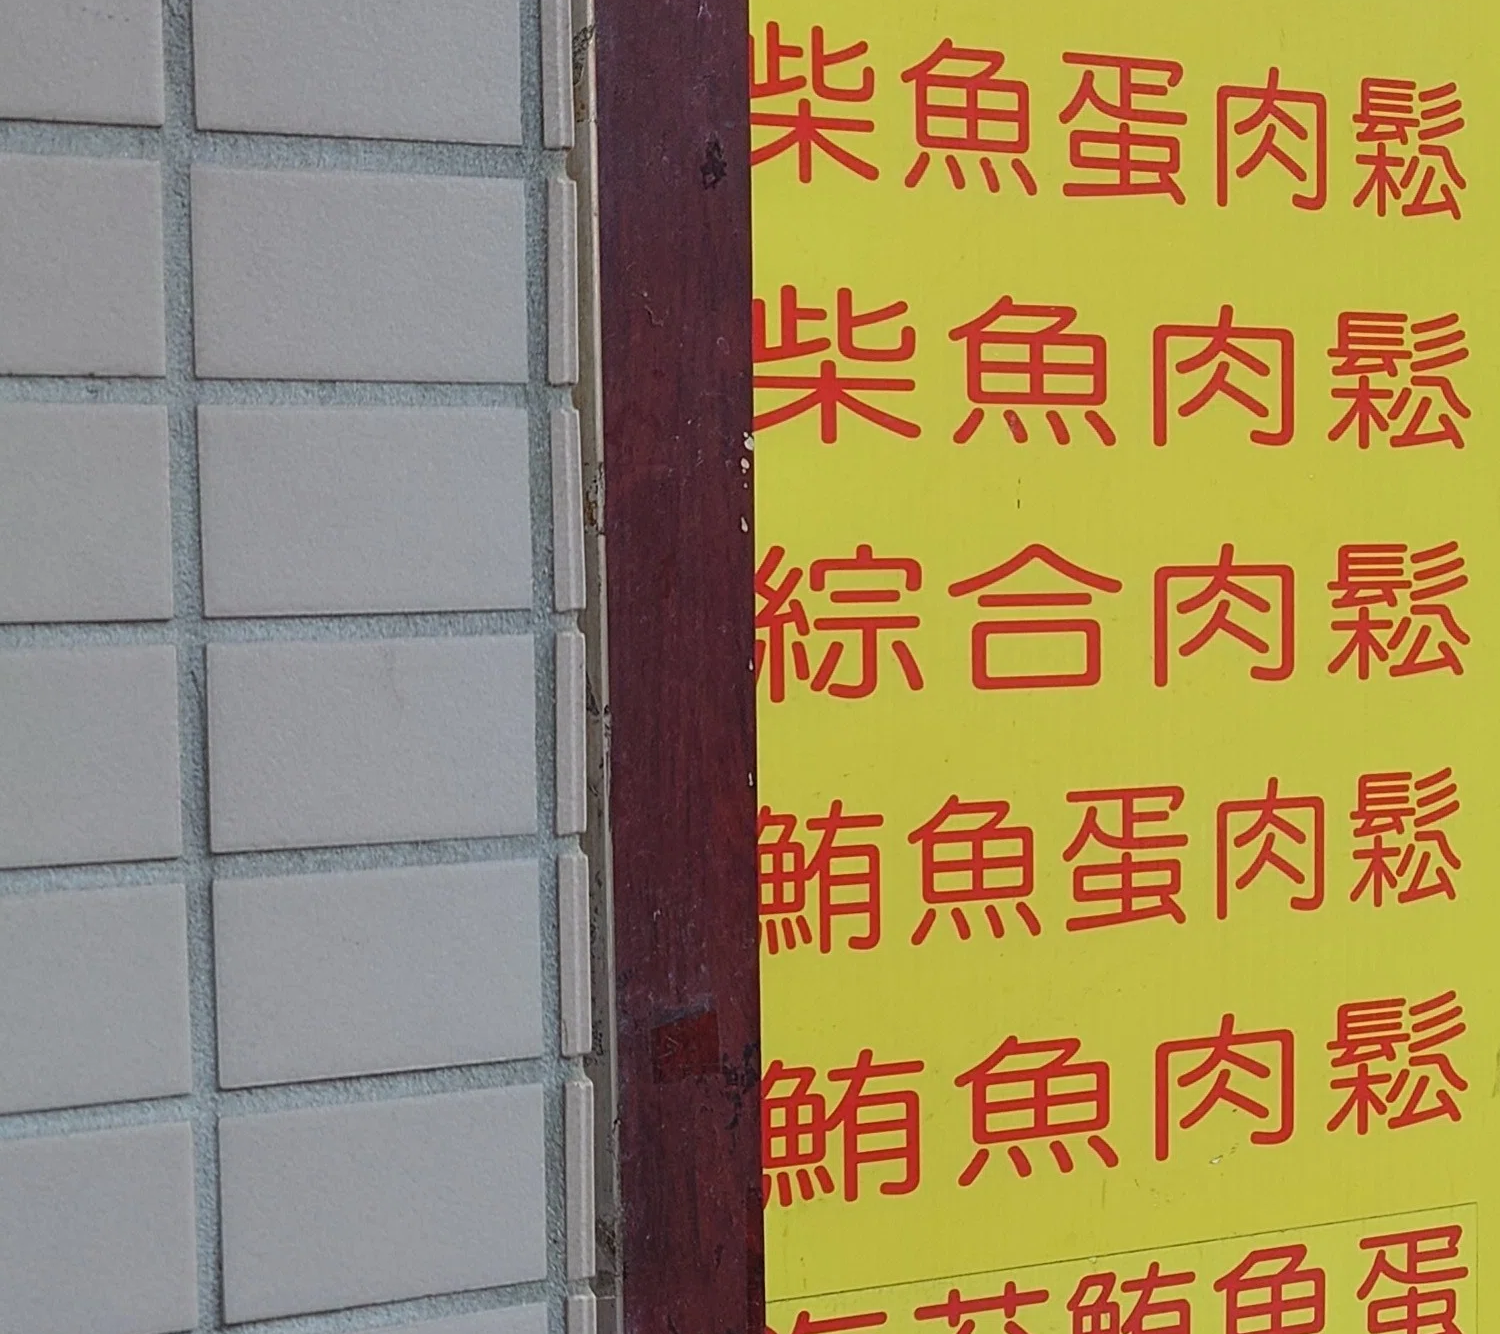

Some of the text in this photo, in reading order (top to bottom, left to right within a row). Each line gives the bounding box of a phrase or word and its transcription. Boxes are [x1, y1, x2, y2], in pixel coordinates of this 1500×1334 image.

[750, 20, 1466, 220] 柴魚蛋肉鬆
[750, 284, 1471, 450] 柴魚肉鬆
[754, 541, 1470, 704] 綜合肉鬆
[757, 768, 1461, 955] 鮪魚蛋肉鬆
[757, 990, 1468, 1210] 鮪魚肉鬆
